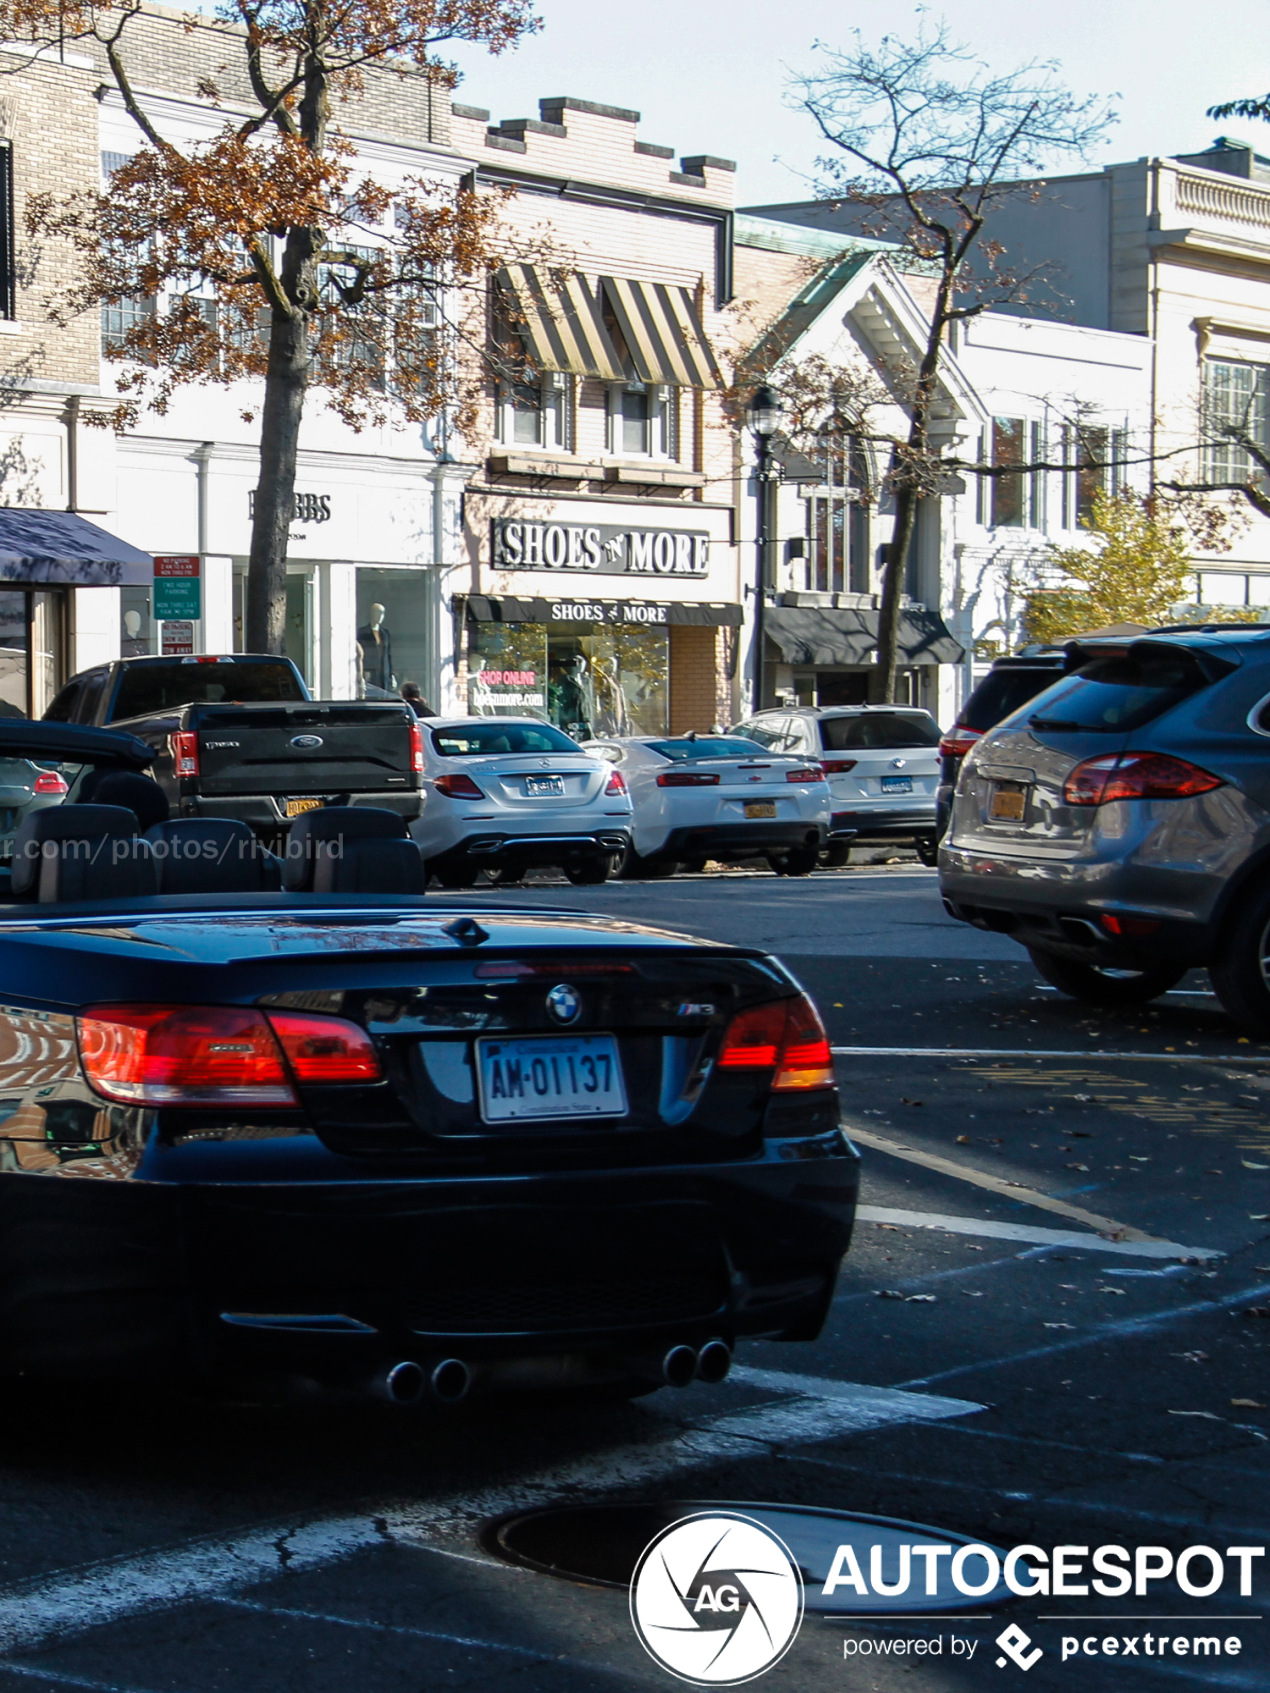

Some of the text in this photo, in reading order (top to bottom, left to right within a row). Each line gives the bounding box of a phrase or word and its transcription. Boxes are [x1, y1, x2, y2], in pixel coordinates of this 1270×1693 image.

[505, 523, 602, 570] SHOES
[628, 531, 710, 574] MORE
[551, 604, 604, 621] SHOES
[623, 605, 667, 622] MORE
[478, 670, 536, 685] SHOP ONLINE
